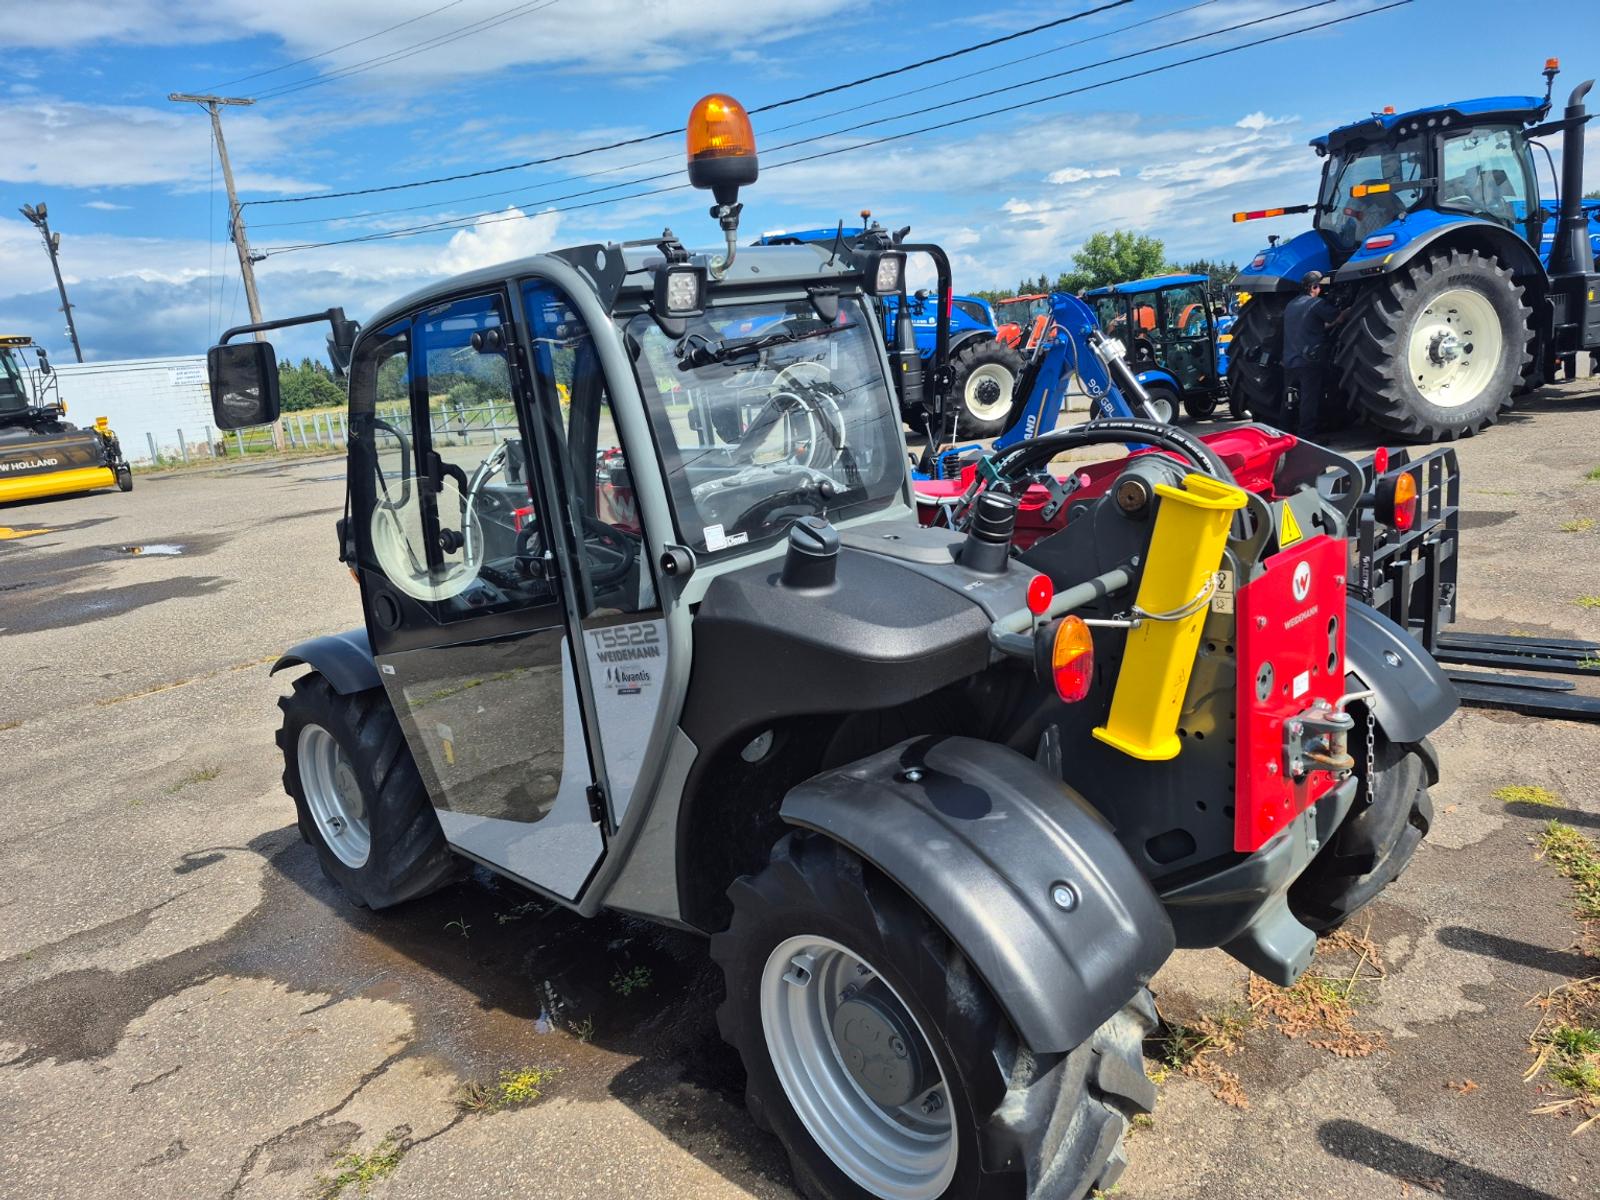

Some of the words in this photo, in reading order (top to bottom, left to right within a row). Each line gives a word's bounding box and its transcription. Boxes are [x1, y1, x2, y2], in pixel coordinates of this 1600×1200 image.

[11, 458, 58, 471] HOLLAND
[1283, 604, 1319, 631] WEIDEMANN
[596, 645, 661, 663] WEIDEMANN
[621, 670, 651, 682] Avantis
